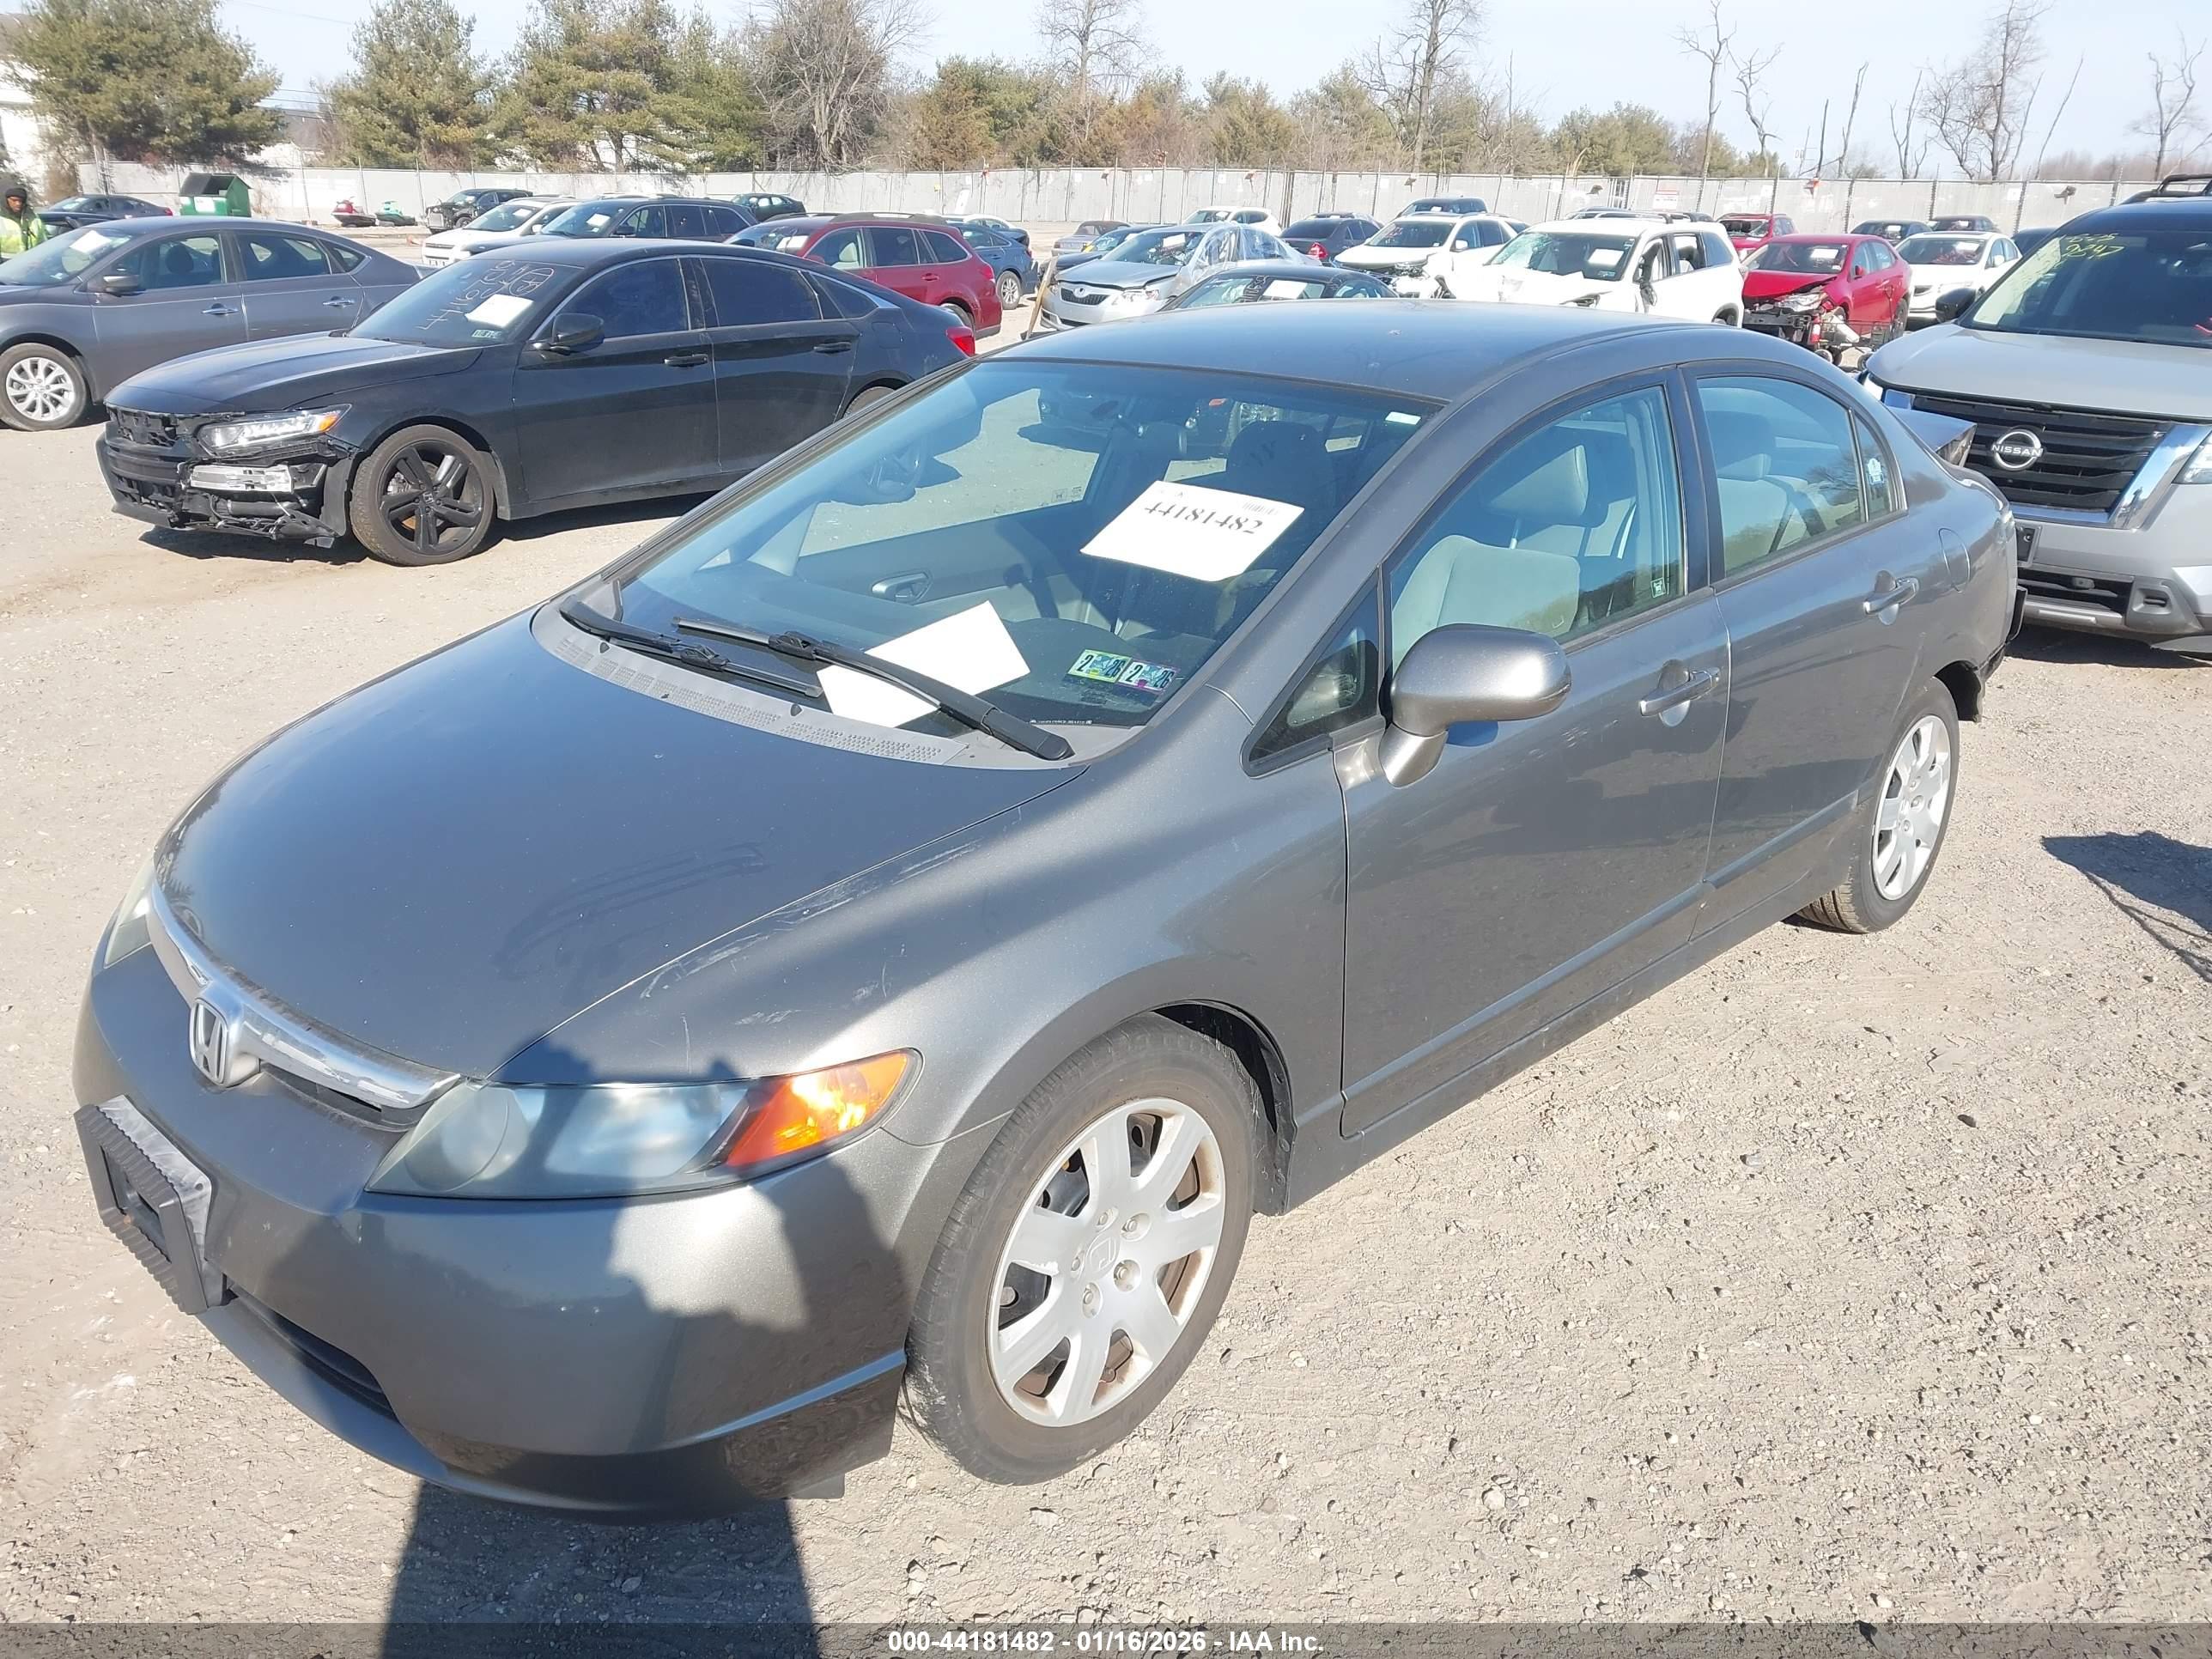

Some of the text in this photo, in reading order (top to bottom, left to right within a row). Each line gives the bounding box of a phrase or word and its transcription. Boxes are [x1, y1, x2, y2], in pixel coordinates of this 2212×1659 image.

[1991, 444, 2044, 458] NISSAN
[1144, 501, 1263, 534] 44181482
[1076, 654, 1126, 678] 2 26
[1125, 664, 1175, 689] 2 26
